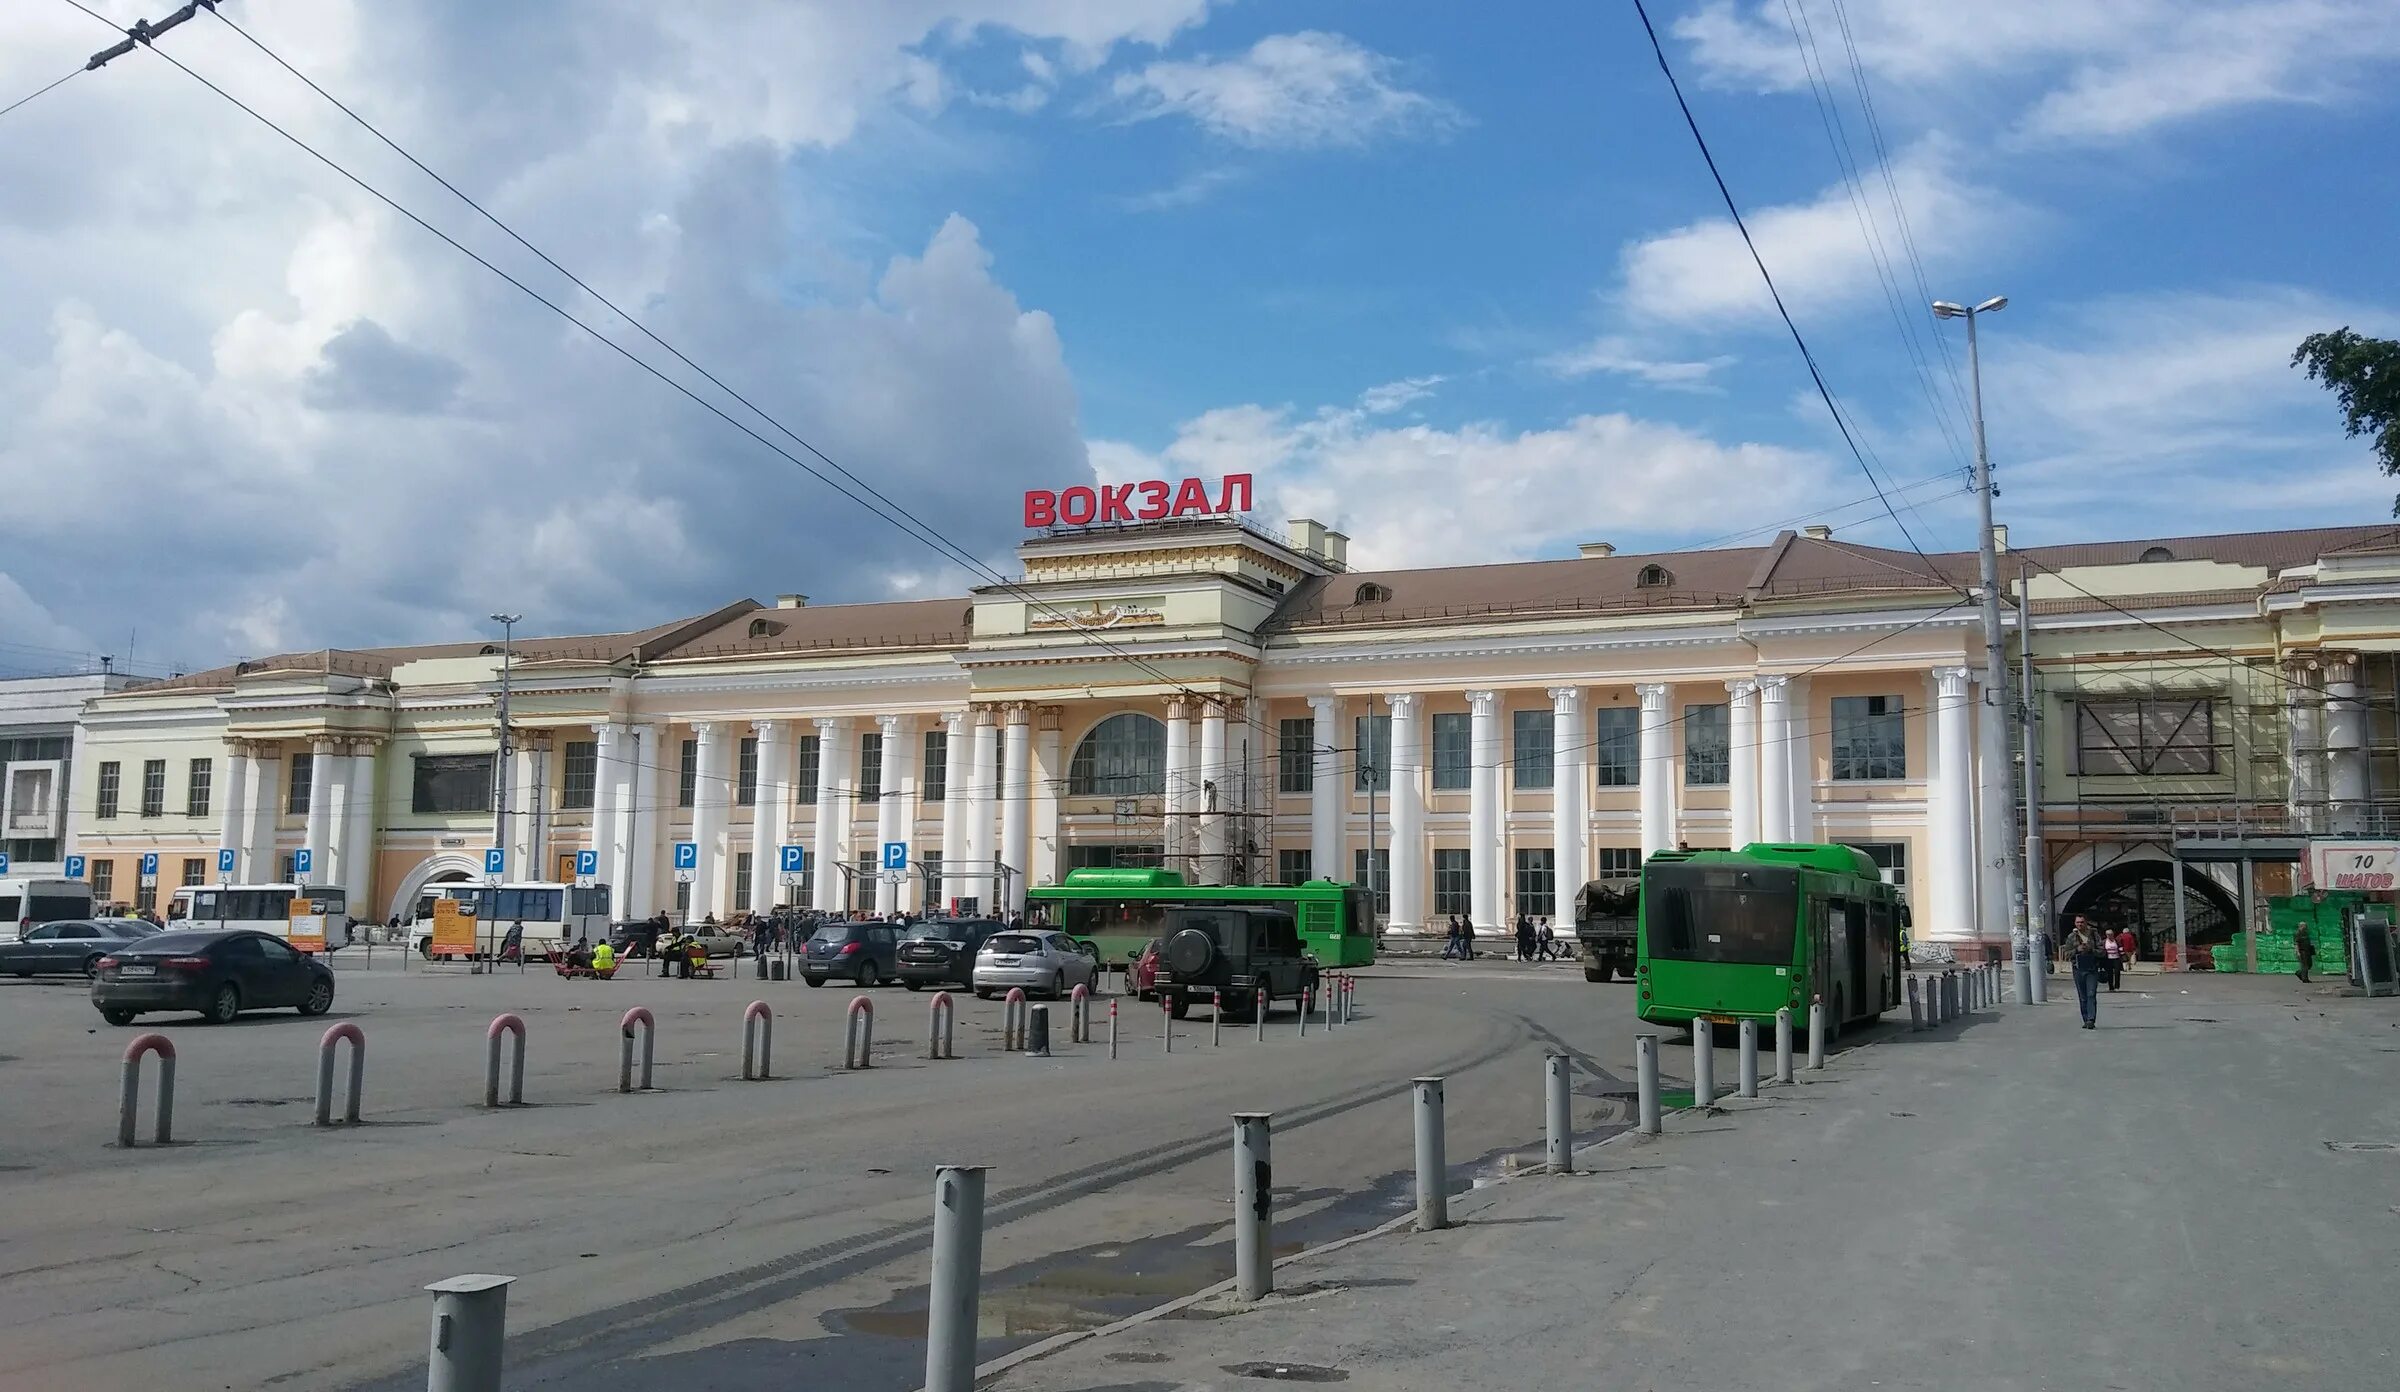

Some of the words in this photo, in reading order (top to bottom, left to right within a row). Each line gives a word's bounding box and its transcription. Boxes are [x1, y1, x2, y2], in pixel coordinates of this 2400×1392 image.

[1024, 473, 1253, 528] ВОКЗАЛ
[147, 855, 155, 873] P
[222, 851, 232, 869] P
[299, 851, 309, 870] P
[490, 851, 501, 871] P
[581, 852, 593, 873] P
[680, 845, 693, 866] P
[787, 848, 799, 869] P
[890, 845, 903, 867] P
[2354, 854, 2375, 869] 10
[70, 857, 81, 875] P
[2335, 872, 2395, 889] ШАГОВ
